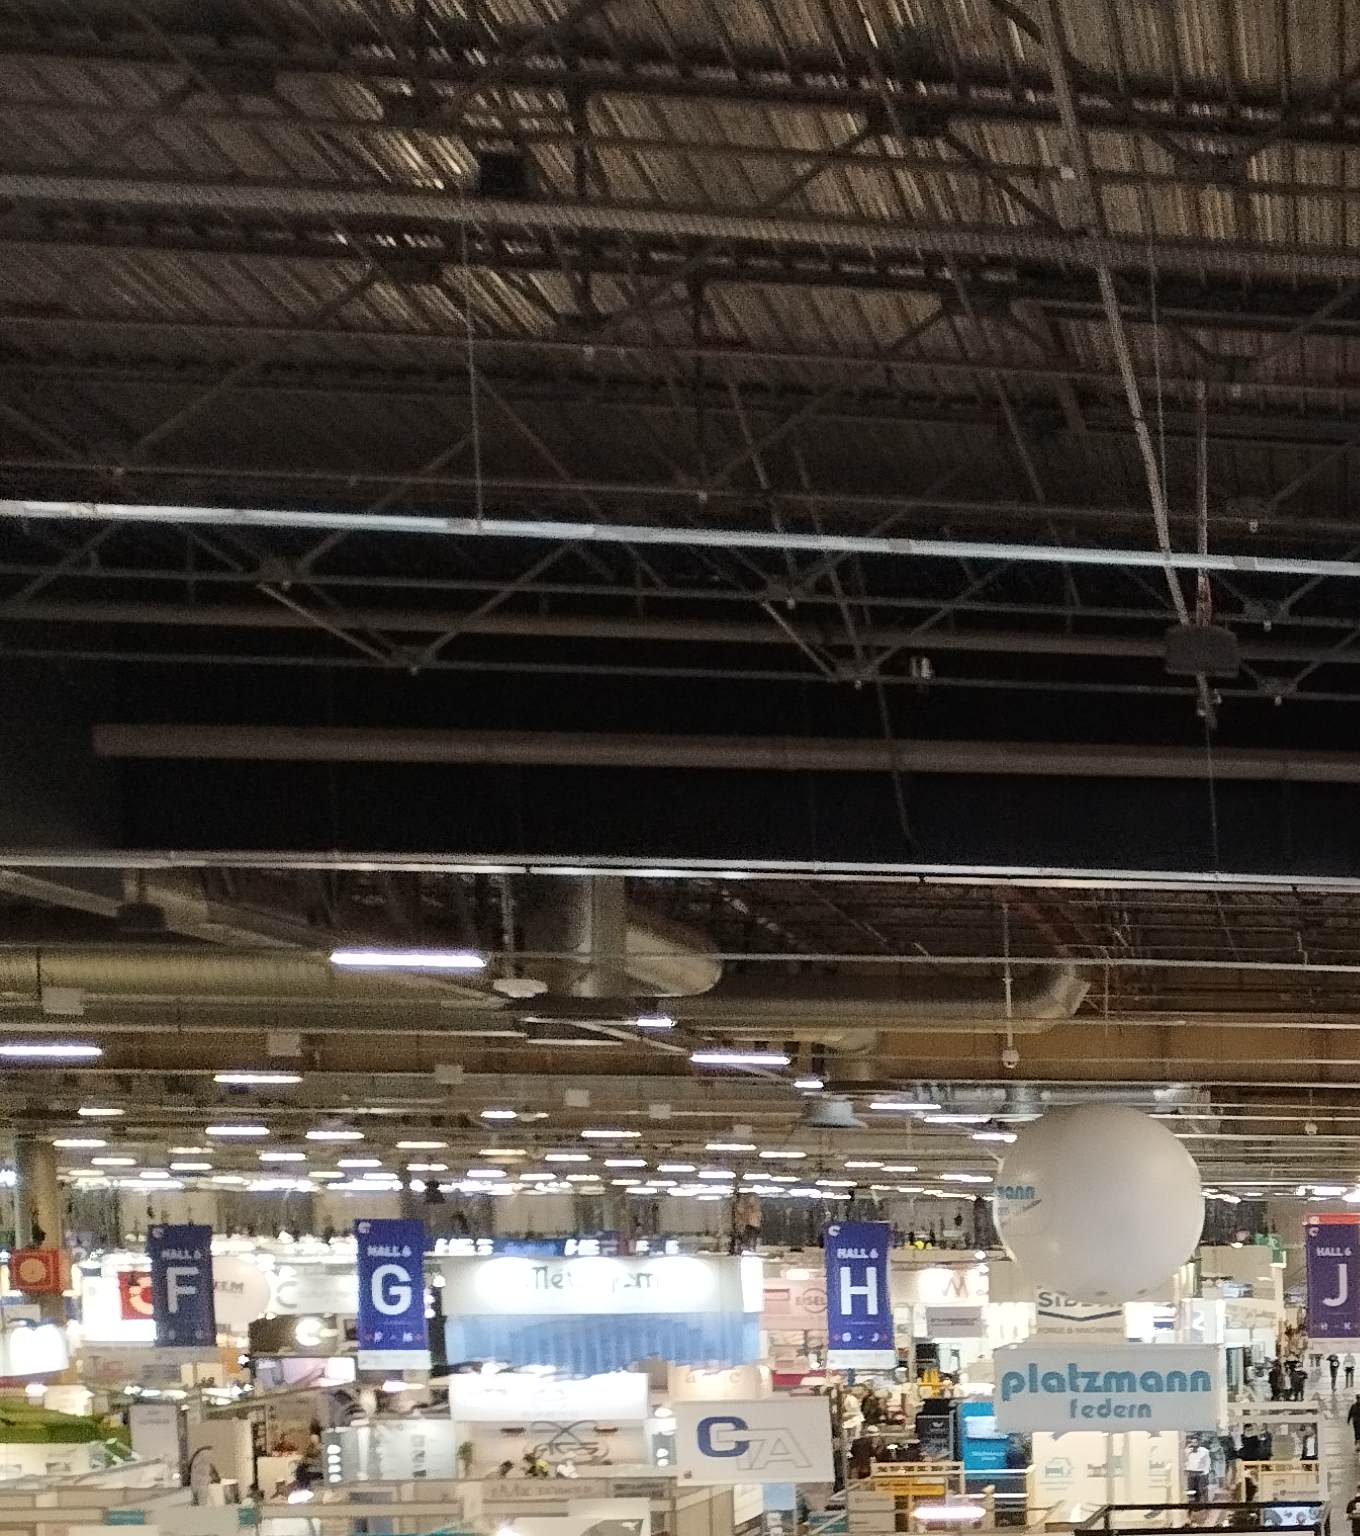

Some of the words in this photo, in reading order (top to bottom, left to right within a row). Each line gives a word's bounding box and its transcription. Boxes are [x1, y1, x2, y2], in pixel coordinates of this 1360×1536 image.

[837, 1248, 868, 1259] HALL
[869, 1248, 879, 1259] 6
[1316, 1247, 1343, 1257] HALL
[1344, 1247, 1352, 1257] 6
[166, 1266, 200, 1314] F
[371, 1263, 412, 1316] G
[839, 1266, 879, 1315] H
[1322, 1263, 1348, 1307] J
[1001, 1362, 1212, 1402] platzmann
[1069, 1398, 1153, 1419] federn
